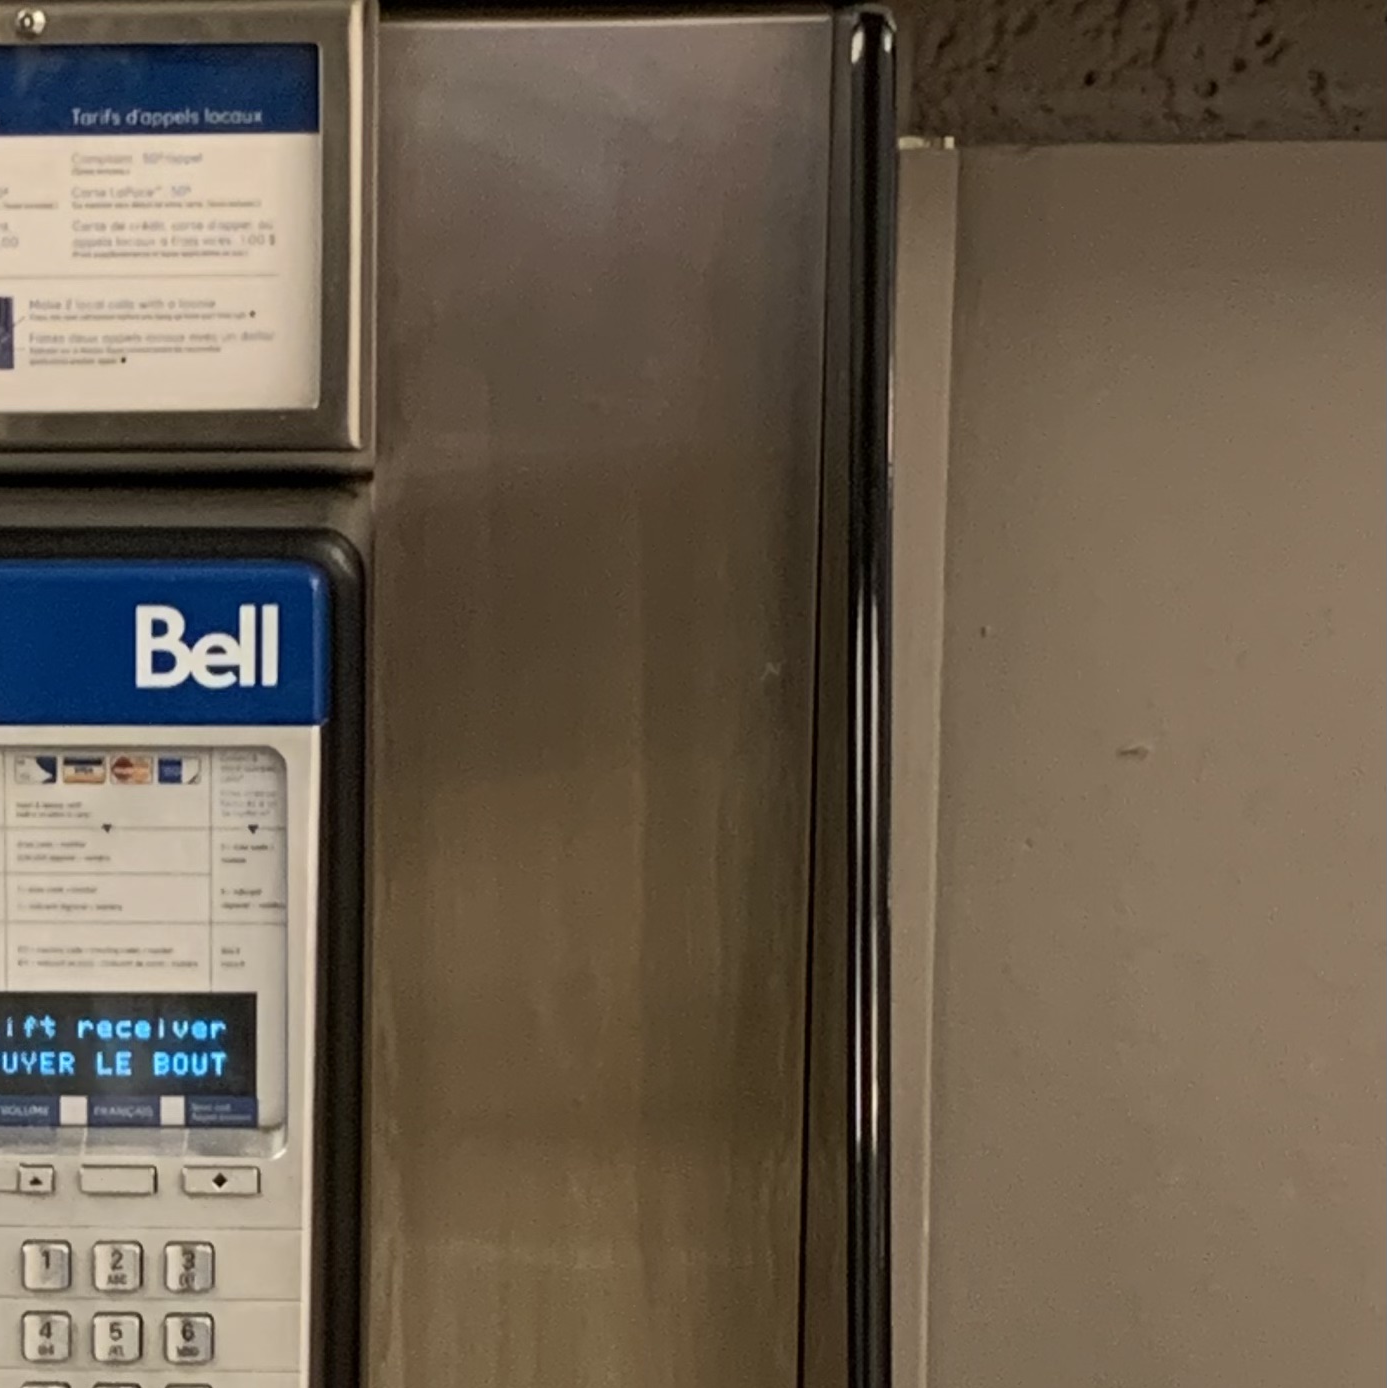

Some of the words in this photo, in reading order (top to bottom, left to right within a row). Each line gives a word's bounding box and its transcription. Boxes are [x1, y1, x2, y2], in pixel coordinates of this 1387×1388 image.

[72, 108, 121, 126] Tarifs
[126, 108, 199, 128] d'appels
[204, 108, 262, 125] locaux
[135, 603, 279, 688] Bell
[77, 1016, 227, 1040] receiver
[96, 1051, 133, 1077] LE
[153, 1052, 227, 1078] BOUT
[0, 1105, 50, 1117] VOLUME
[42, 1250, 50, 1270] 1
[110, 1250, 123, 1271] 2
[182, 1250, 196, 1271] 3
[39, 1321, 52, 1339] 4
[109, 1322, 123, 1341] 5
[181, 1322, 195, 1342] 6
